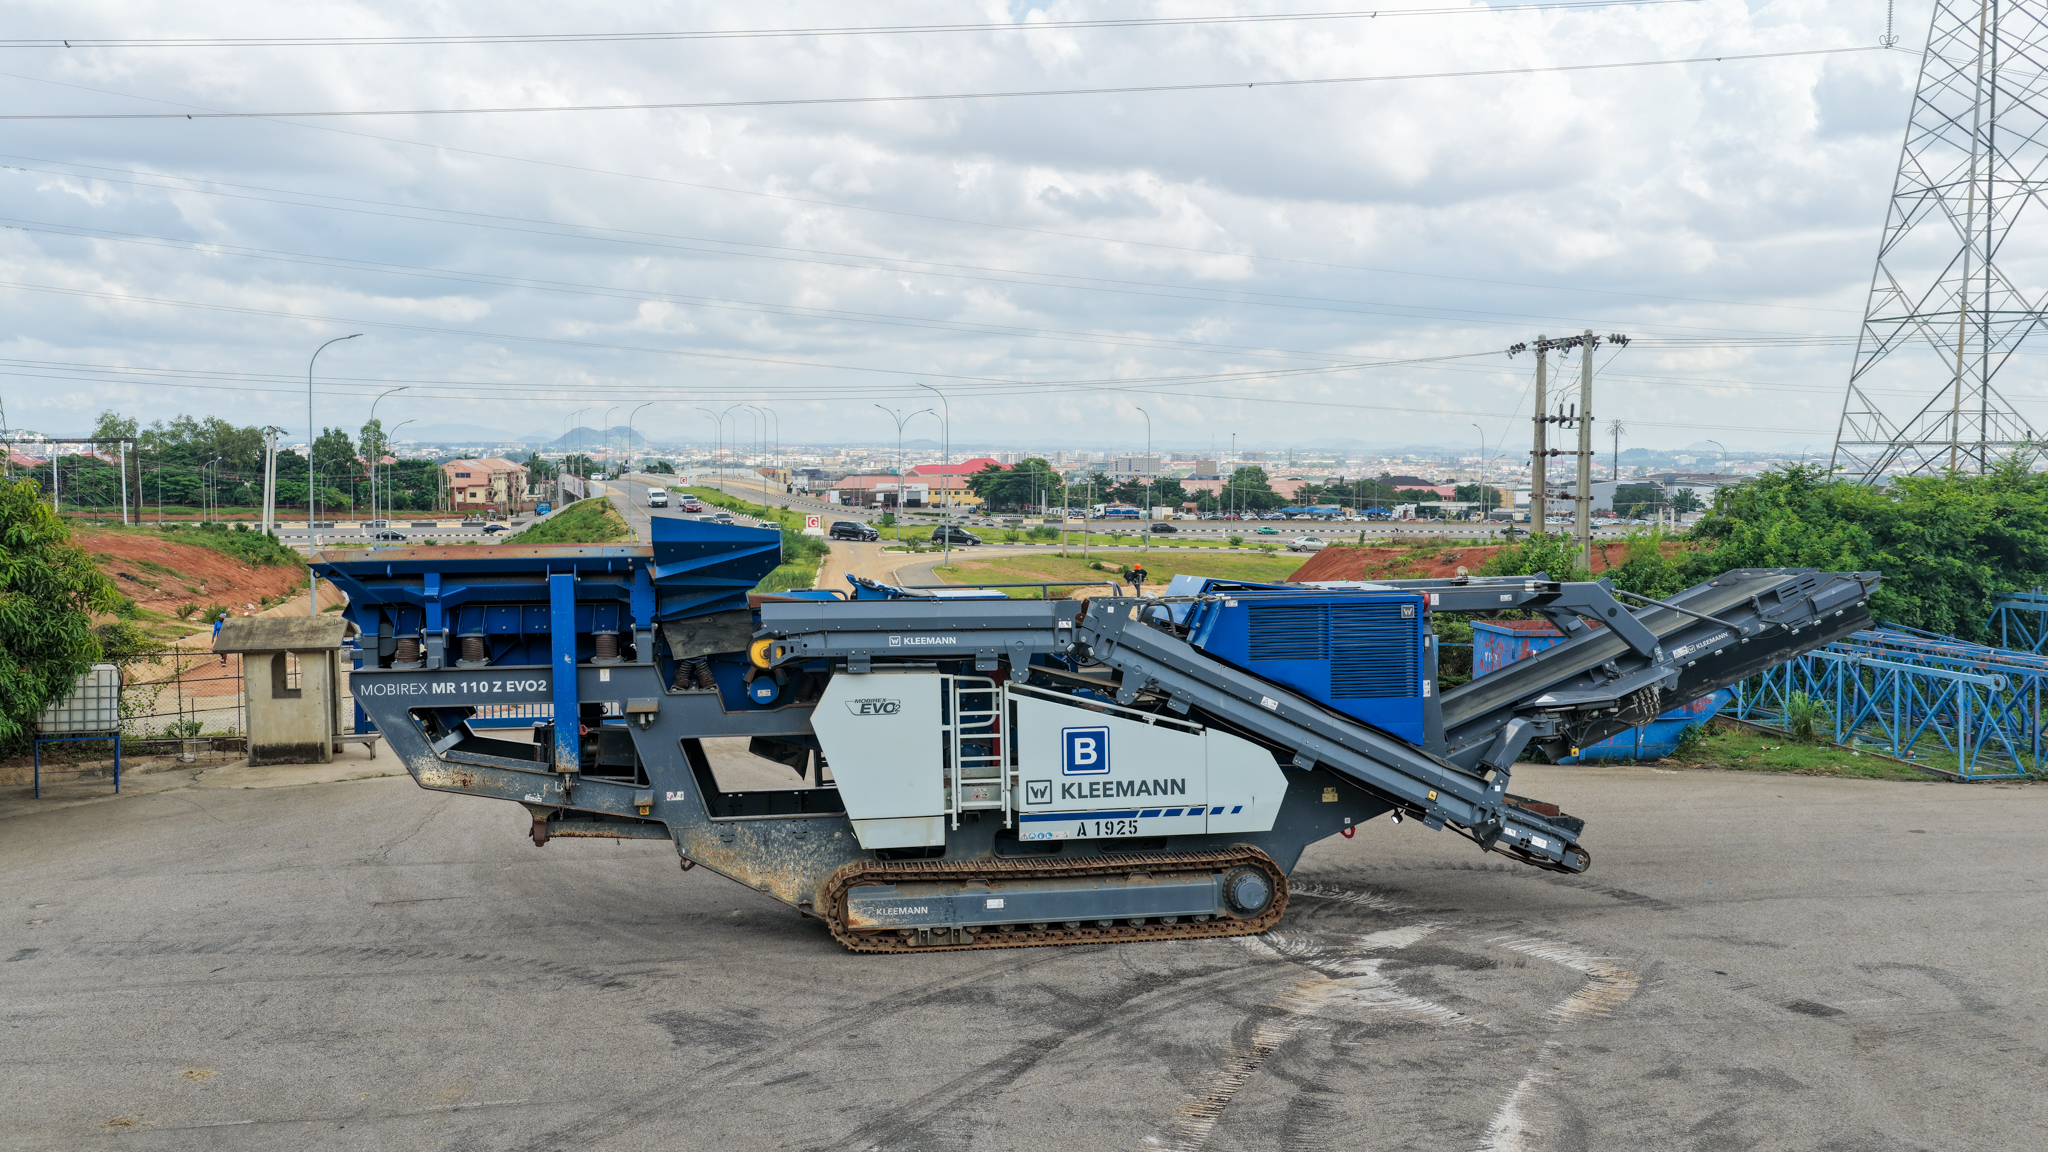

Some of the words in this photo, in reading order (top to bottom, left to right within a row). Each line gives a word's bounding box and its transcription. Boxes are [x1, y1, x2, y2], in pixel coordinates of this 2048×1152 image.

[809, 517, 818, 527] G
[903, 636, 957, 645] KLEEMANN
[1695, 631, 1729, 650] KLEEMANN
[360, 683, 429, 696] MOBIREX
[432, 682, 456, 694] MR
[460, 681, 489, 693] 110
[492, 681, 503, 693] Z
[506, 680, 547, 692] EVO2
[1074, 737, 1098, 765] B
[1061, 778, 1186, 800] KLEEMANN
[1076, 822, 1087, 837] A
[1094, 820, 1138, 837] 1925
[876, 906, 928, 916] KLEEMANN
